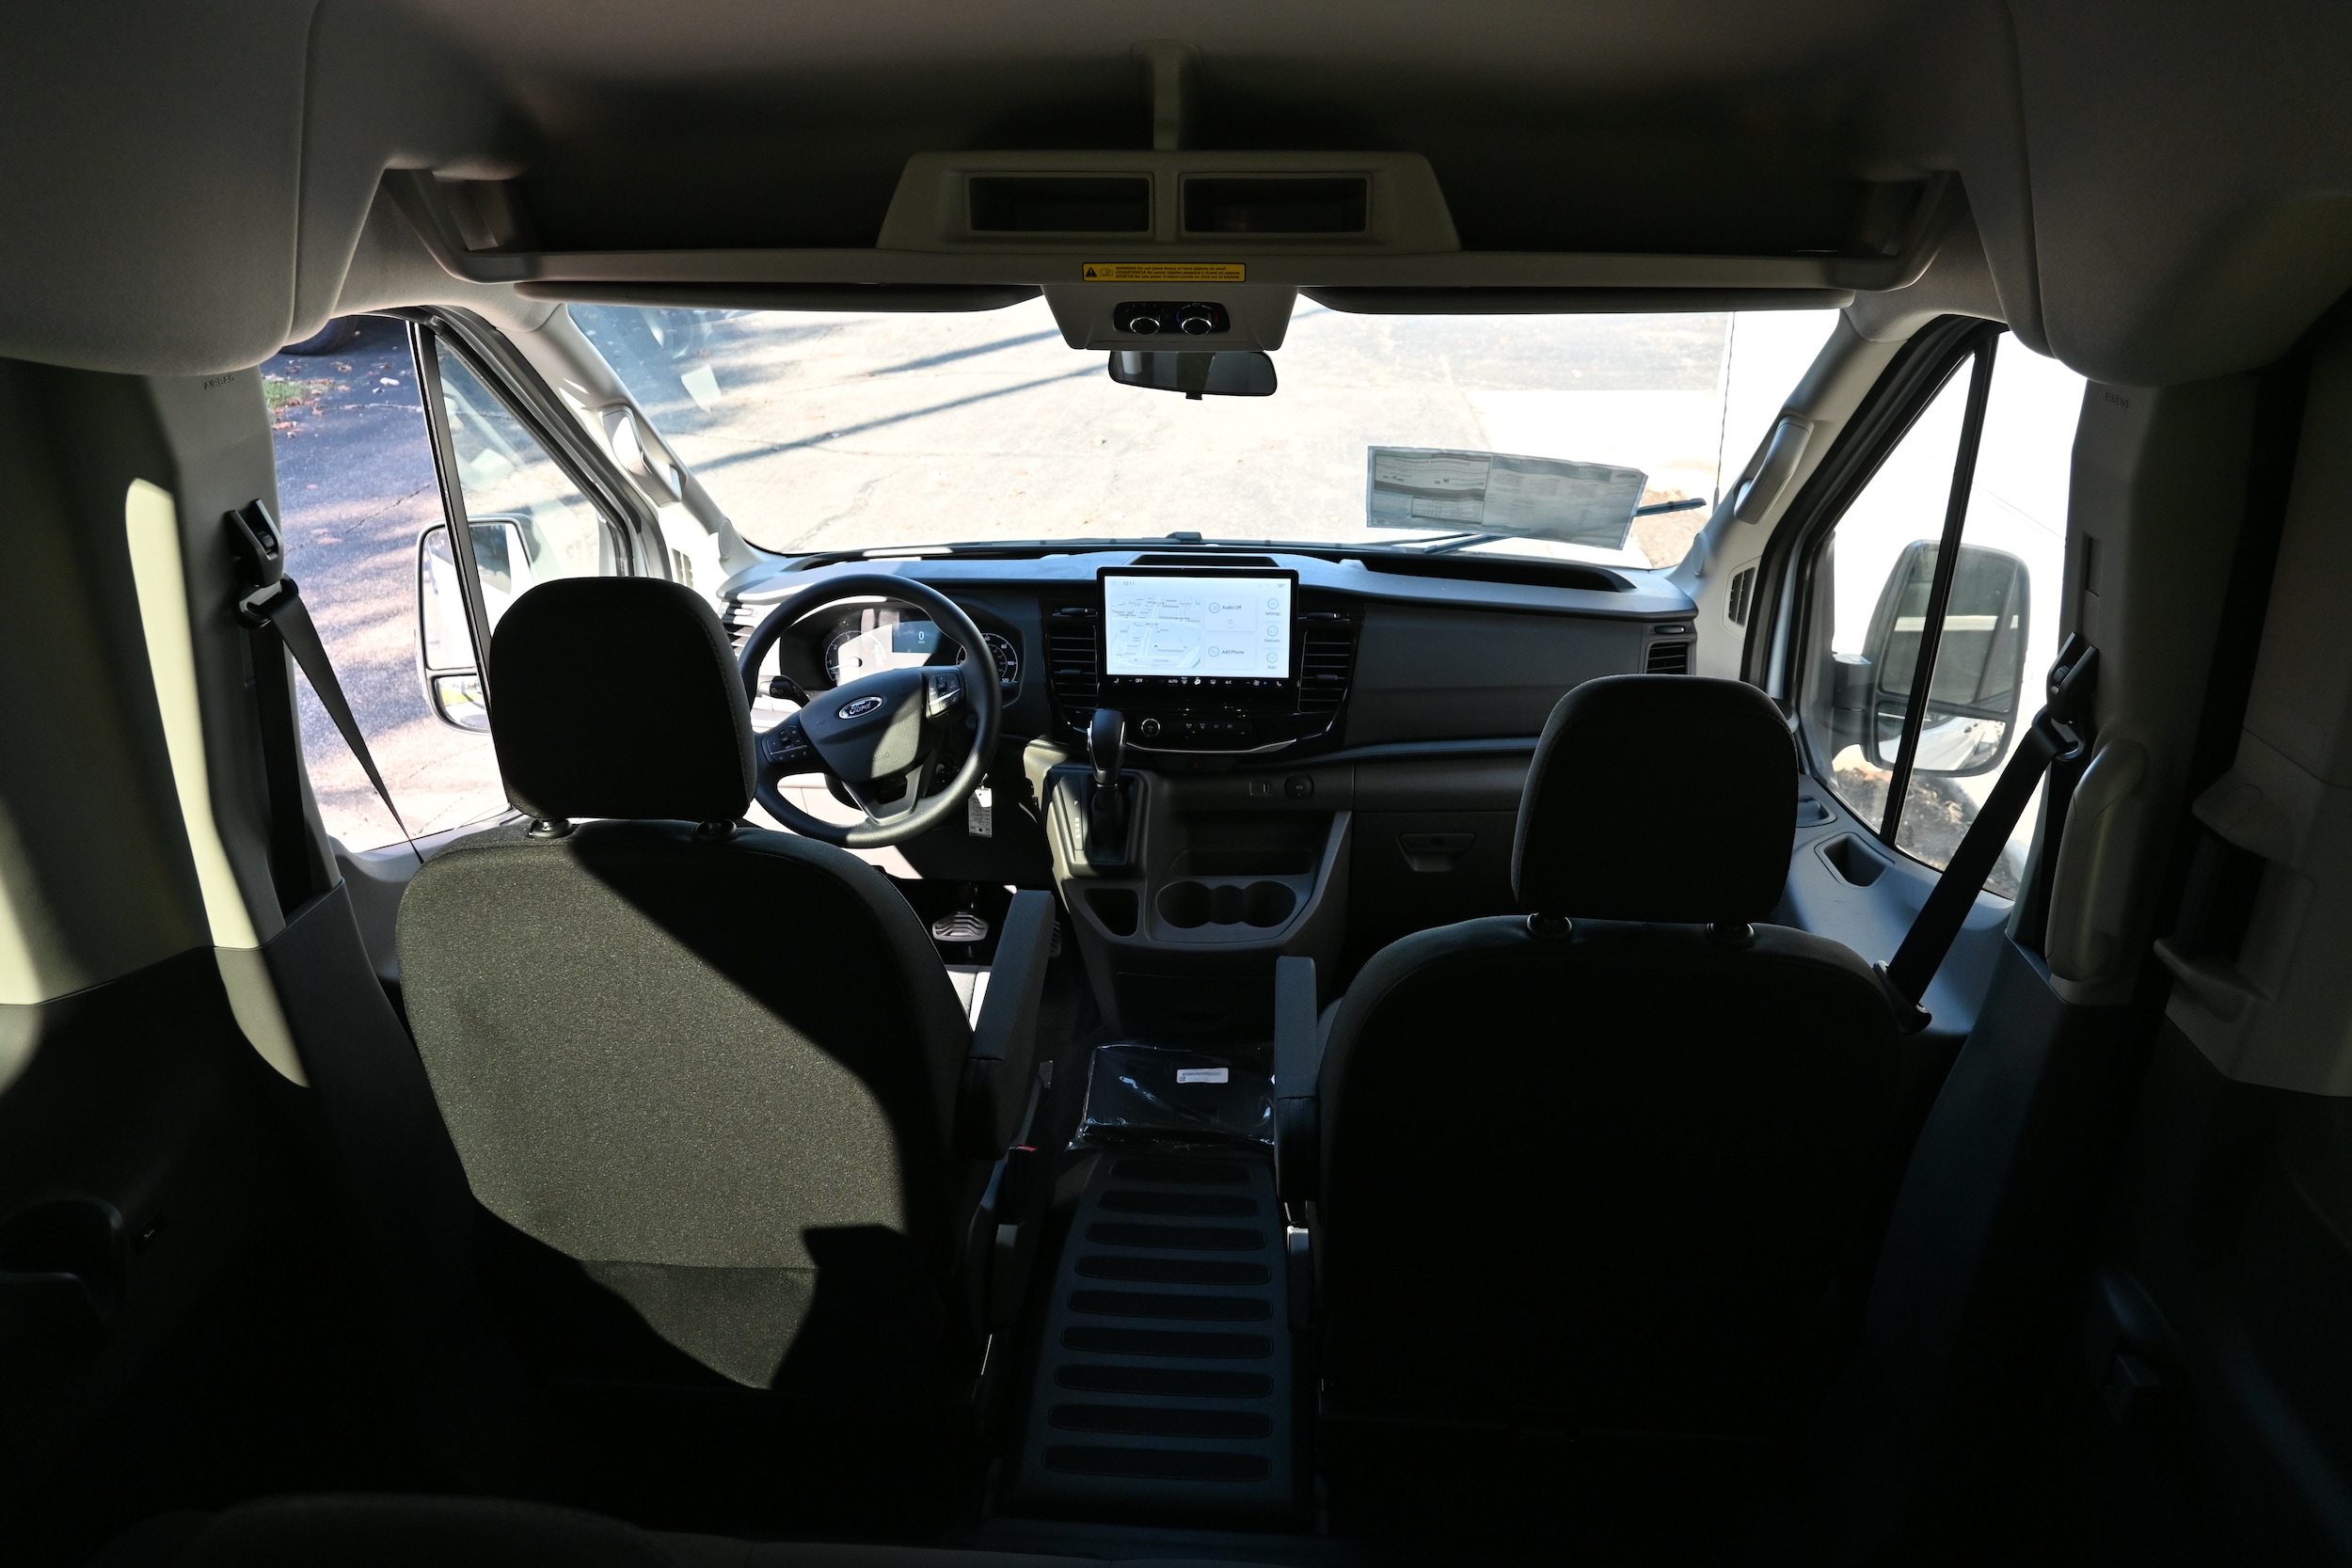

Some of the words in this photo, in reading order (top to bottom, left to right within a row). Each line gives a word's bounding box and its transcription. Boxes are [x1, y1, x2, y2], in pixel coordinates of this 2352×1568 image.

[204, 374, 236, 390] AIRBAG
[918, 630, 925, 641] 0
[849, 701, 871, 715] Ford
